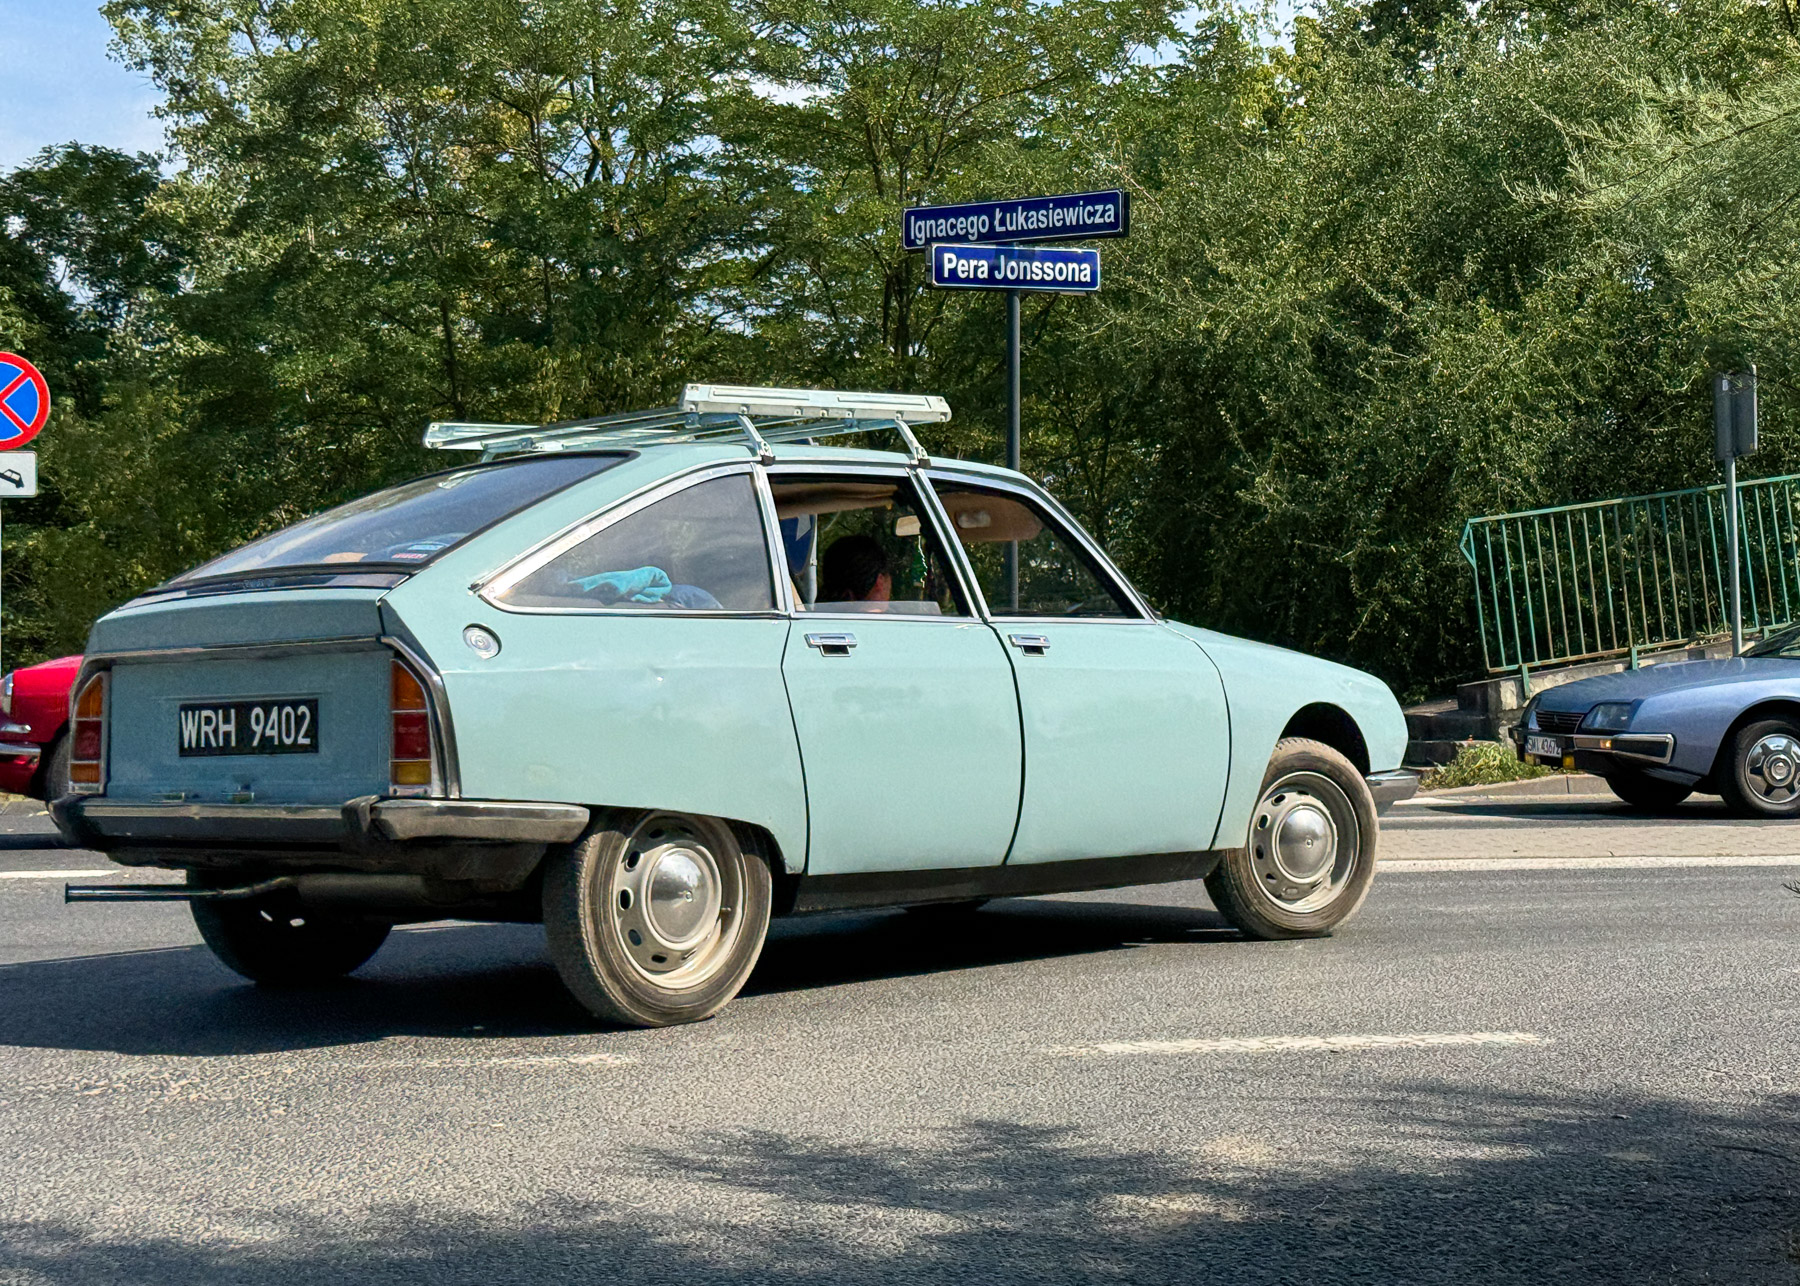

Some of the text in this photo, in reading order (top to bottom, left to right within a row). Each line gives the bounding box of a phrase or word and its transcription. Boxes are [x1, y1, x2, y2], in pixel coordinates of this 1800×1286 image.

[910, 201, 1115, 245] Ignacego Łukasiewicza
[943, 253, 1091, 282] Pera Jonssona
[181, 705, 311, 748] WRH 9402
